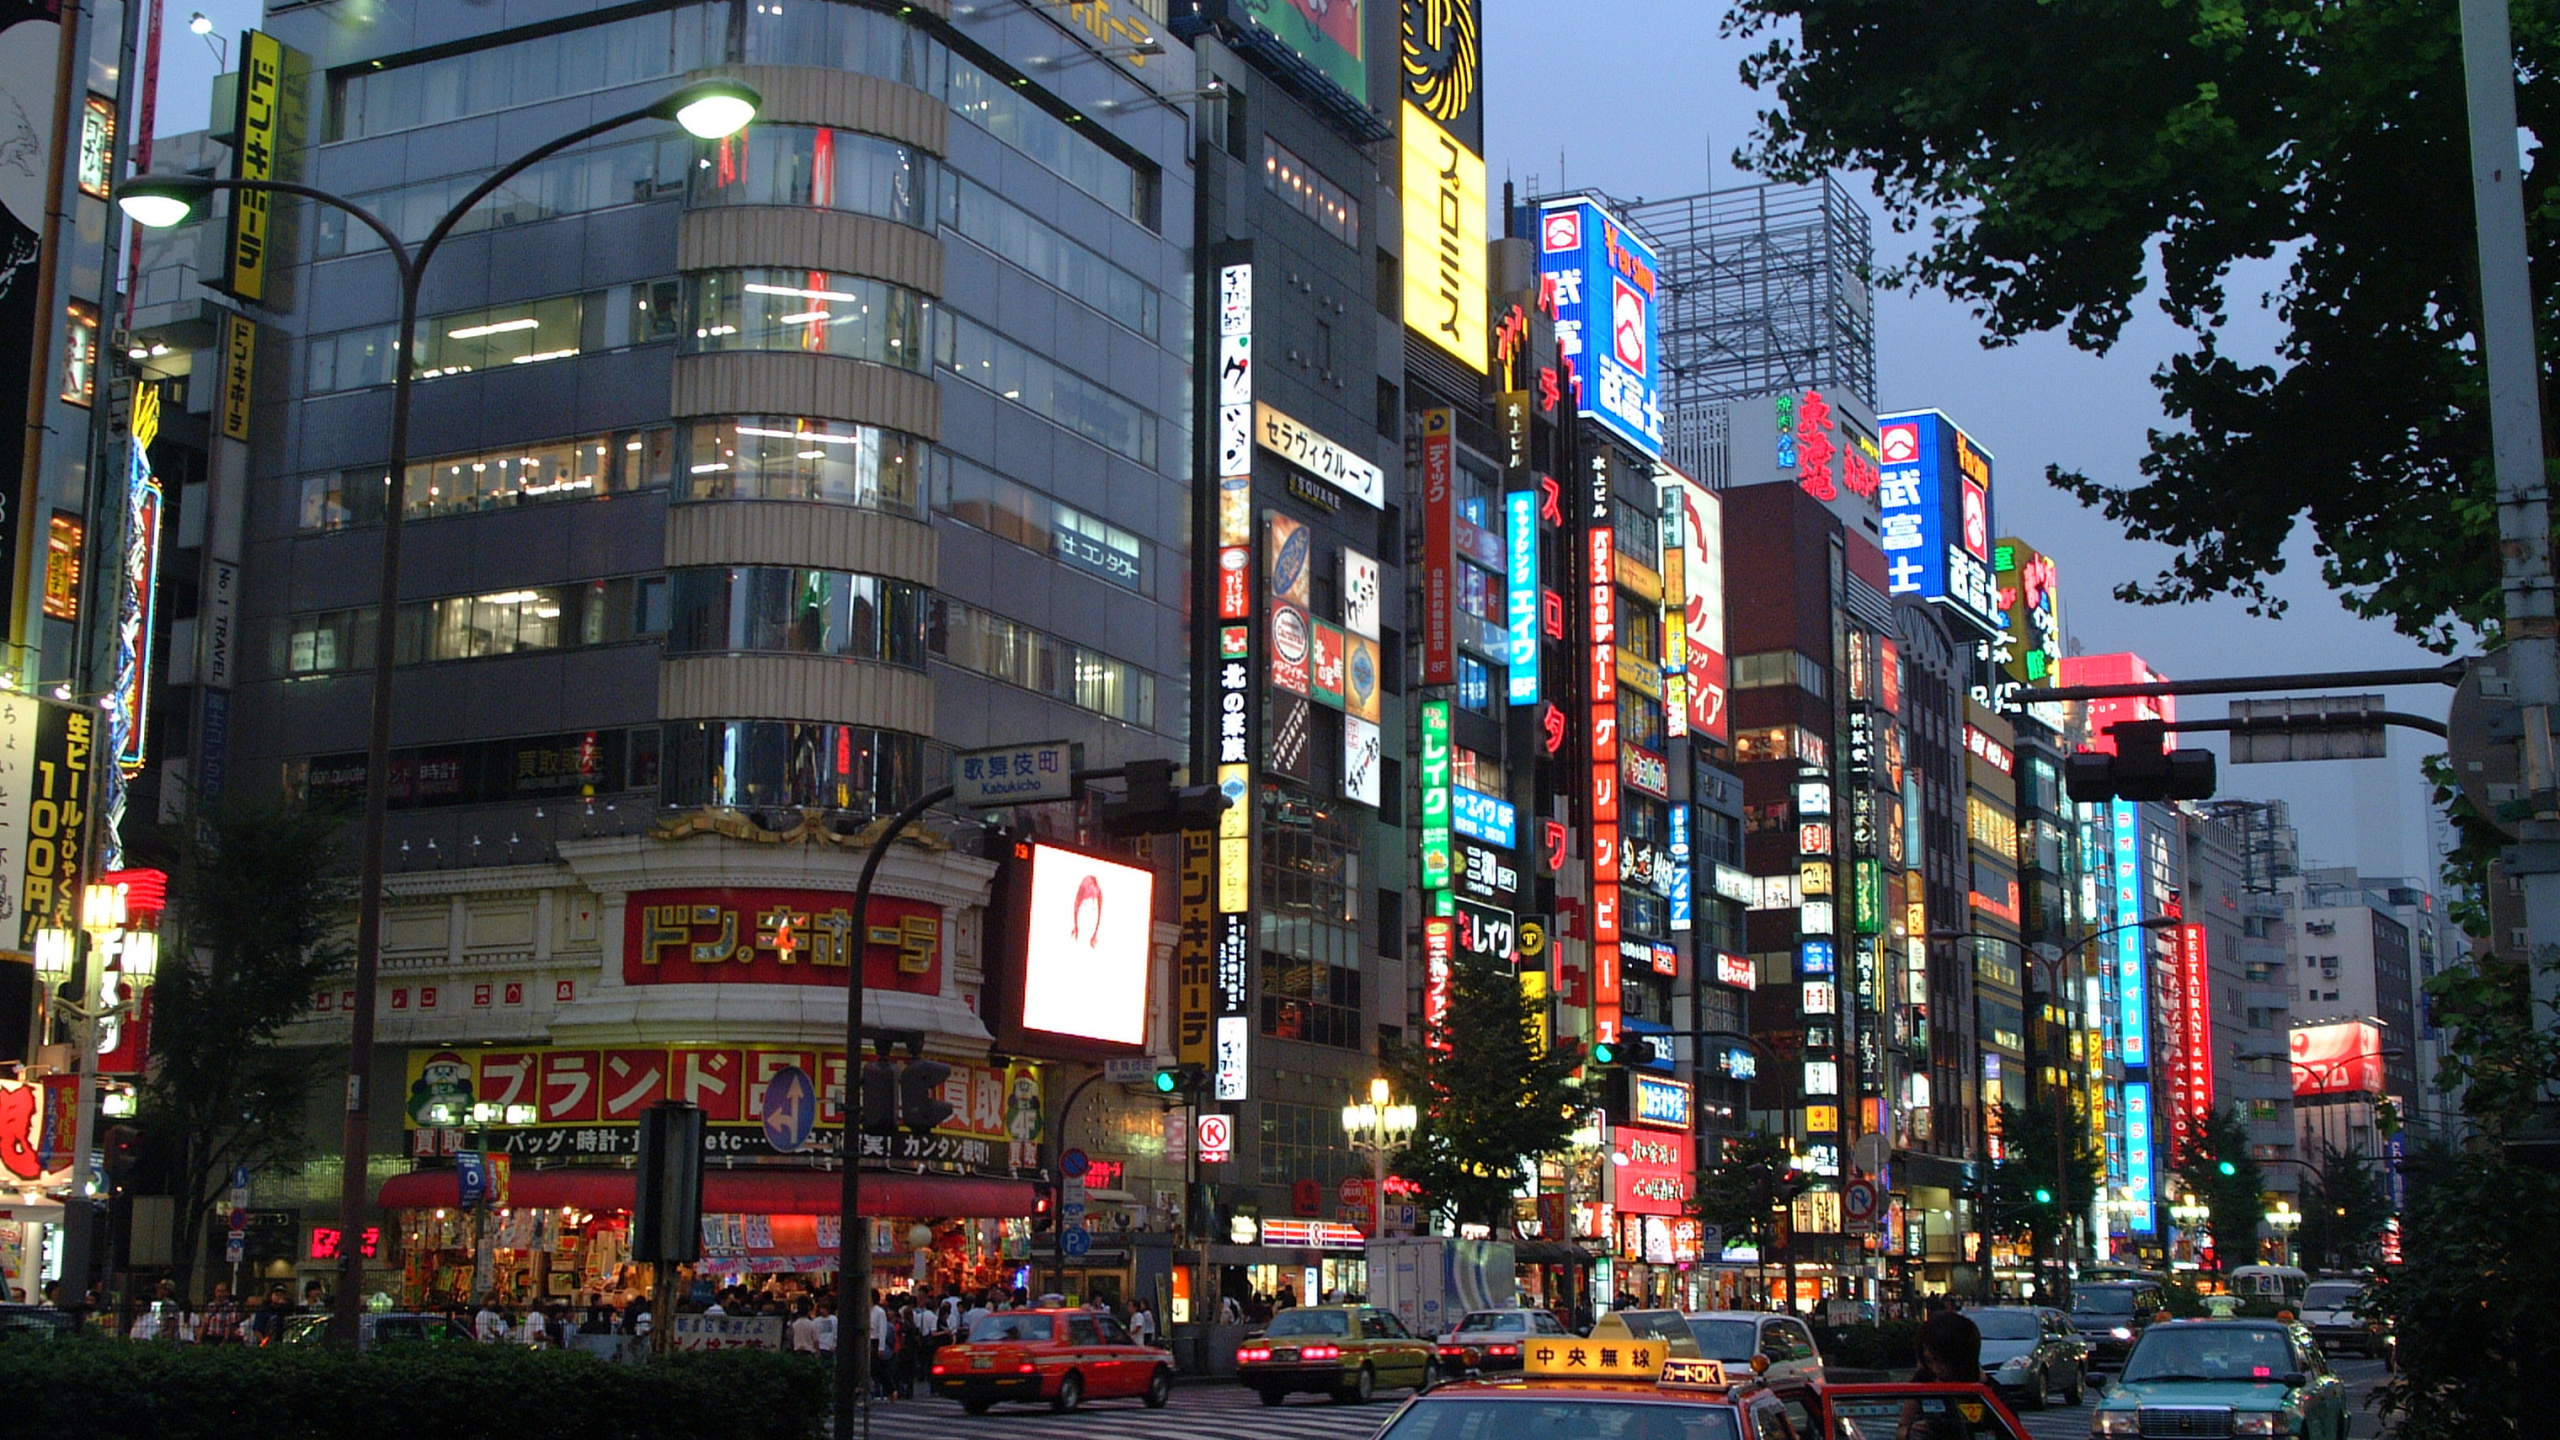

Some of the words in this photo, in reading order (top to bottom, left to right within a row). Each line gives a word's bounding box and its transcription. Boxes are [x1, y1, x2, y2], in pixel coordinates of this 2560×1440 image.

[1440, 136, 1460, 343] プロミス
[1546, 268, 1582, 382] 武富
[1599, 352, 1664, 446] 武富士
[1266, 414, 1374, 494] セラヴィグループ
[1508, 402, 1523, 468] 水上ビル
[1298, 476, 1341, 510] SQUARE
[1430, 444, 1447, 503] ディック
[1592, 456, 1607, 518] 水上ビル
[1880, 469, 1924, 593] 武富士
[1950, 543, 2003, 625] 武富士
[212, 615, 229, 682] TRAVEL
[1511, 590, 1536, 665] エイワ
[1221, 663, 1247, 762] 北の家族
[420, 762, 460, 781] 時計
[964, 751, 1059, 781] 歌舞伎町
[981, 779, 1041, 795] Kabukicho
[1424, 734, 1447, 814] レイク
[58, 712, 91, 923] 生ビールがひゃくえ
[1467, 794, 1496, 823] エイワ
[1673, 868, 1690, 919] 747
[1182, 836, 1208, 1046] ドン・キホーテ
[1472, 914, 1512, 959] レイク
[2115, 797, 2141, 1053] ラオケ&パーティー館
[2188, 928, 2204, 1044] RESTAURANT
[484, 1051, 1003, 1127] ブランド品高買取
[2292, 1065, 2349, 1091] アコム
[415, 1128, 465, 1155] 買取
[506, 1129, 639, 1153] バッグ・時計・
[1009, 1142, 1037, 1167] 買取
[1010, 1108, 1036, 1141] 4F
[1067, 1233, 1079, 1250] P
[1704, 1226, 1717, 1241] P
[1536, 1346, 1651, 1367] 中央無線
[1663, 1364, 1718, 1384] カードOK
